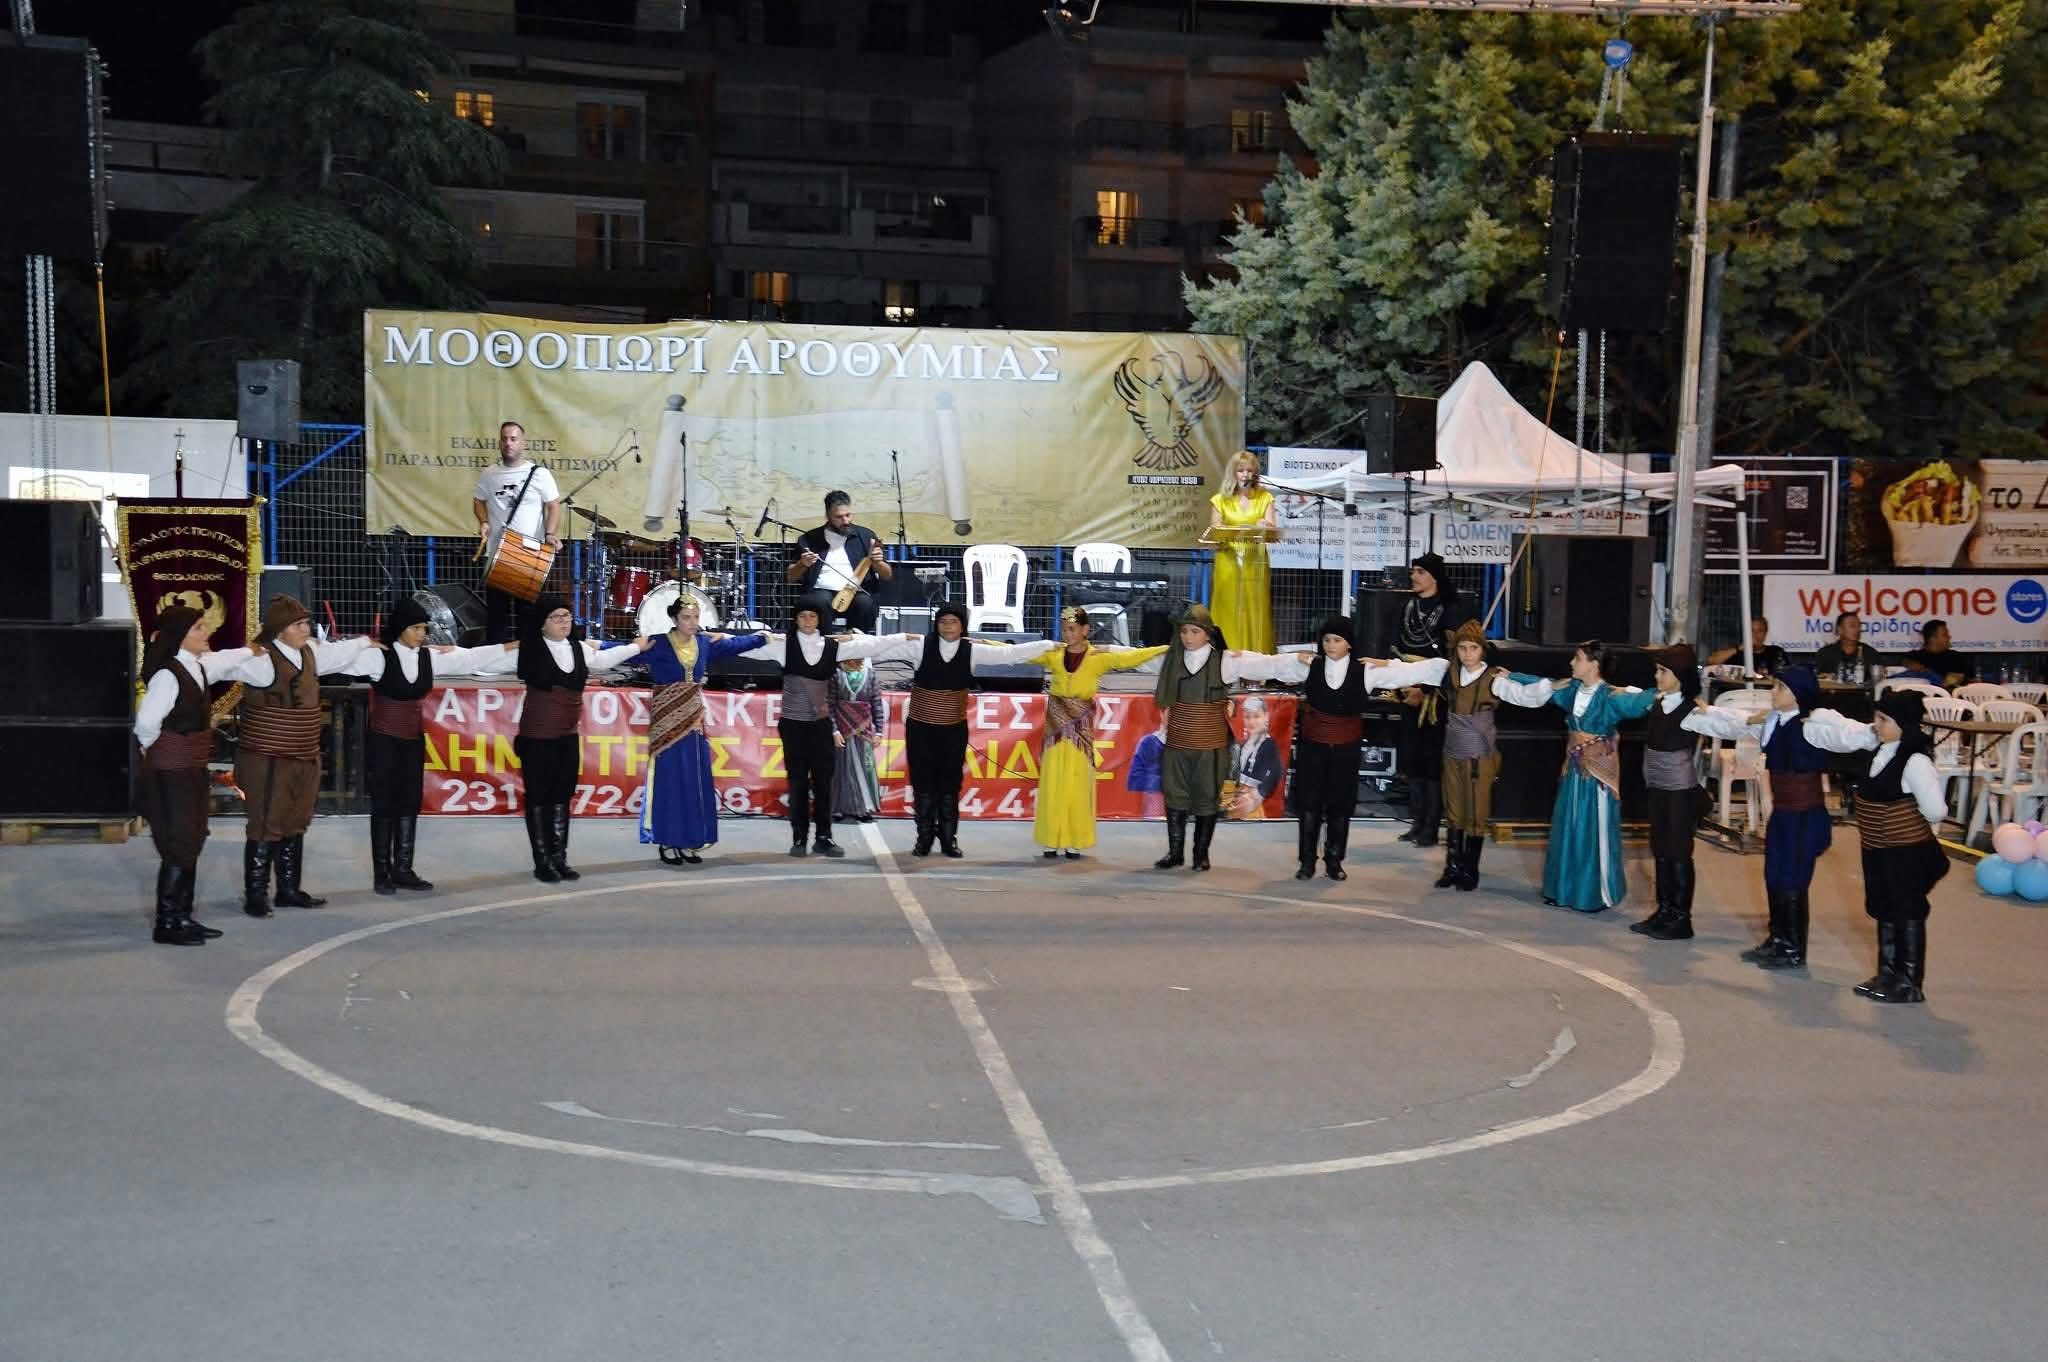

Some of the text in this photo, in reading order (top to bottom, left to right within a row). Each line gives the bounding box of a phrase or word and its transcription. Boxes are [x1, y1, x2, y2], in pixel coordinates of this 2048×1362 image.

[384, 326, 1061, 382] ΜΟΘΟΠΩΡΙ ΑΡΟΘΥΜΙΑΣ
[450, 436, 557, 452] ΕΚΔΗΣΕΙΣ
[385, 452, 490, 468] ΠΑΡΑΔΟΣΗΣ
[1988, 487, 2023, 510] το
[1798, 578, 1997, 617] welcome
[1806, 618, 1923, 637] Μααρίδης
